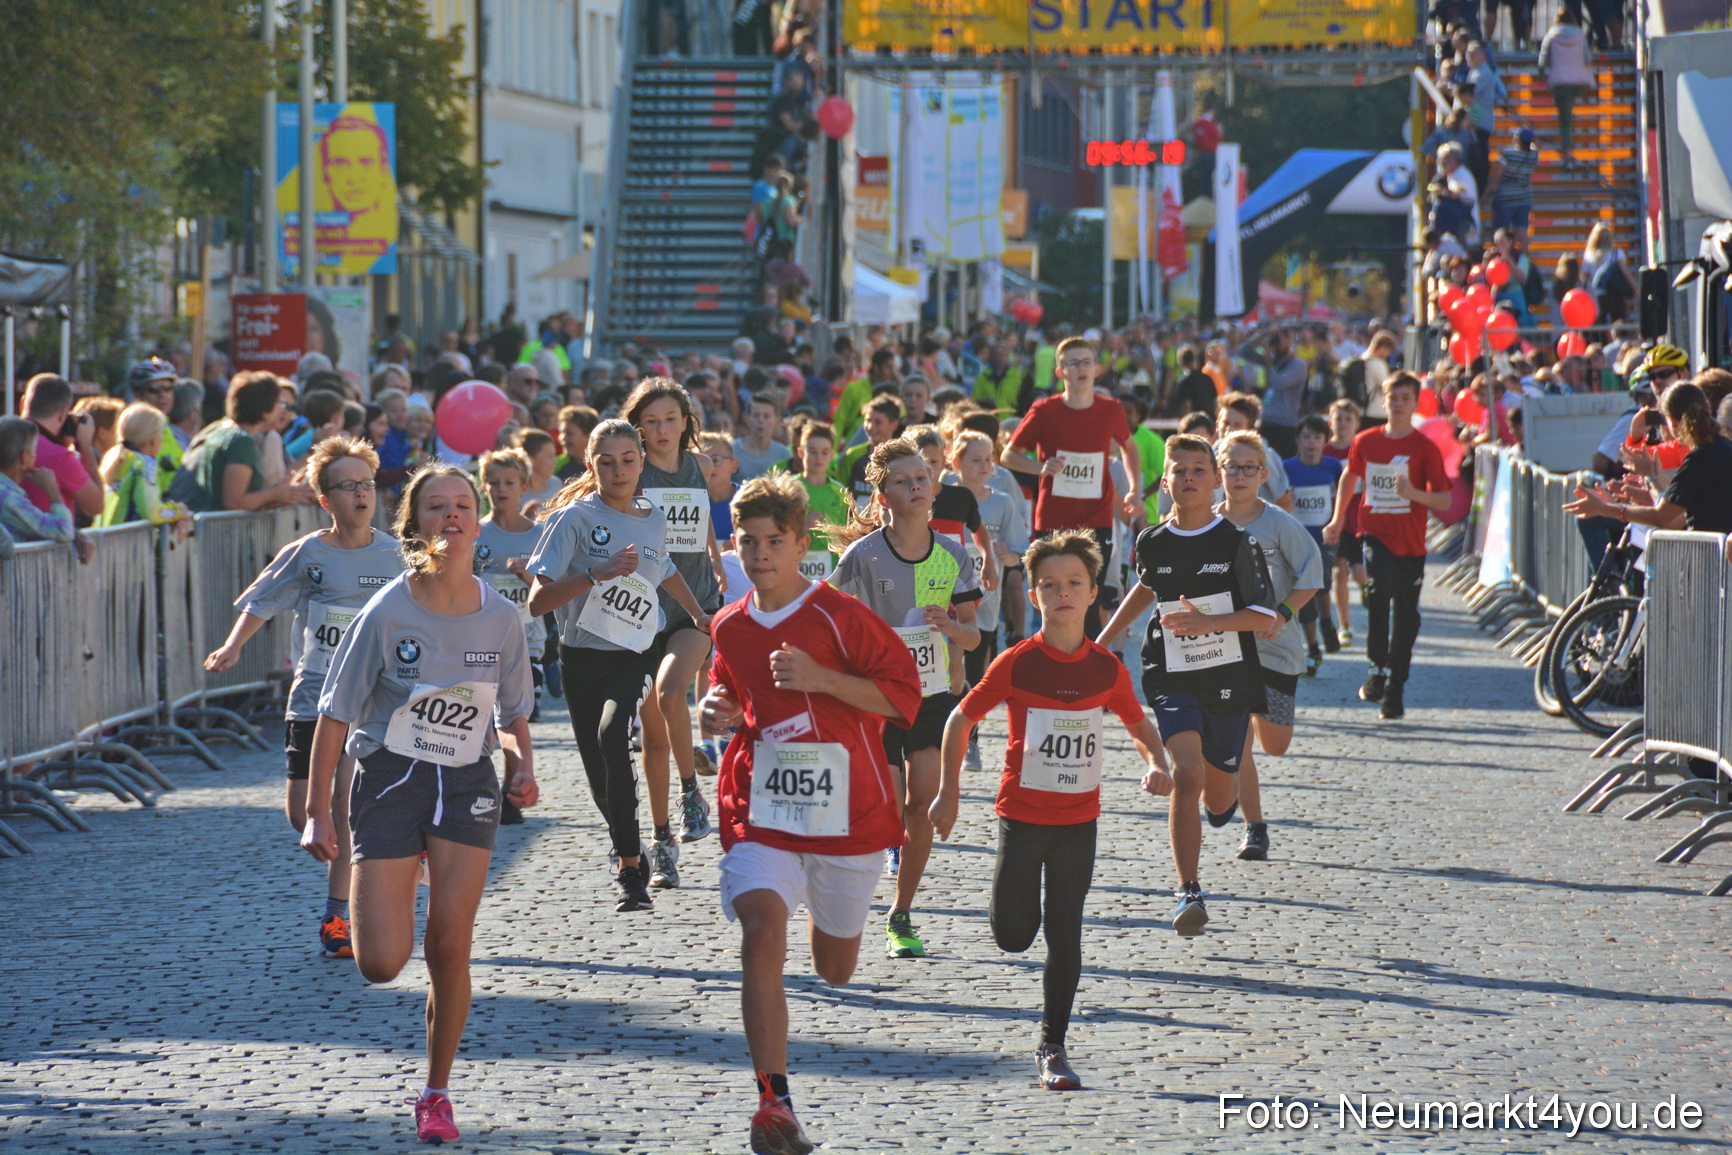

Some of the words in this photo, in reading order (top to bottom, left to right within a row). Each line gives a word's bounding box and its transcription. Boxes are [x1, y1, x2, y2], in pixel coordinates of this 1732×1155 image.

[1033, 0, 1213, 31] START
[1062, 465, 1094, 479] 4041
[1296, 497, 1325, 510] 4039
[676, 536, 697, 547] Ronja
[589, 547, 610, 555] PARTL
[799, 562, 825, 576] 009
[1157, 566, 1173, 574] JAKO
[621, 576, 648, 594] BOCK
[499, 588, 528, 604] 040
[601, 585, 652, 621] 4047
[601, 607, 616, 618] PARTL
[616, 614, 637, 627] Neumarkt
[901, 632, 930, 642] BOCK
[909, 643, 934, 667] 031
[1184, 648, 1224, 663] Benedikt
[397, 667, 420, 675] PARTL
[1220, 689, 1232, 699] 15
[410, 697, 479, 732] 4022
[411, 722, 431, 734] PARTL
[431, 728, 459, 739] Neumarkt
[1053, 718, 1090, 728] BOCK
[773, 723, 796, 739] DEHN
[413, 736, 456, 757] Samina
[1038, 733, 1096, 759] 4016
[777, 750, 819, 761] BOCK
[765, 768, 834, 796] 4054
[1057, 774, 1078, 785] Phil
[475, 796, 495, 808] NIKE
[769, 804, 804, 821] TIM
